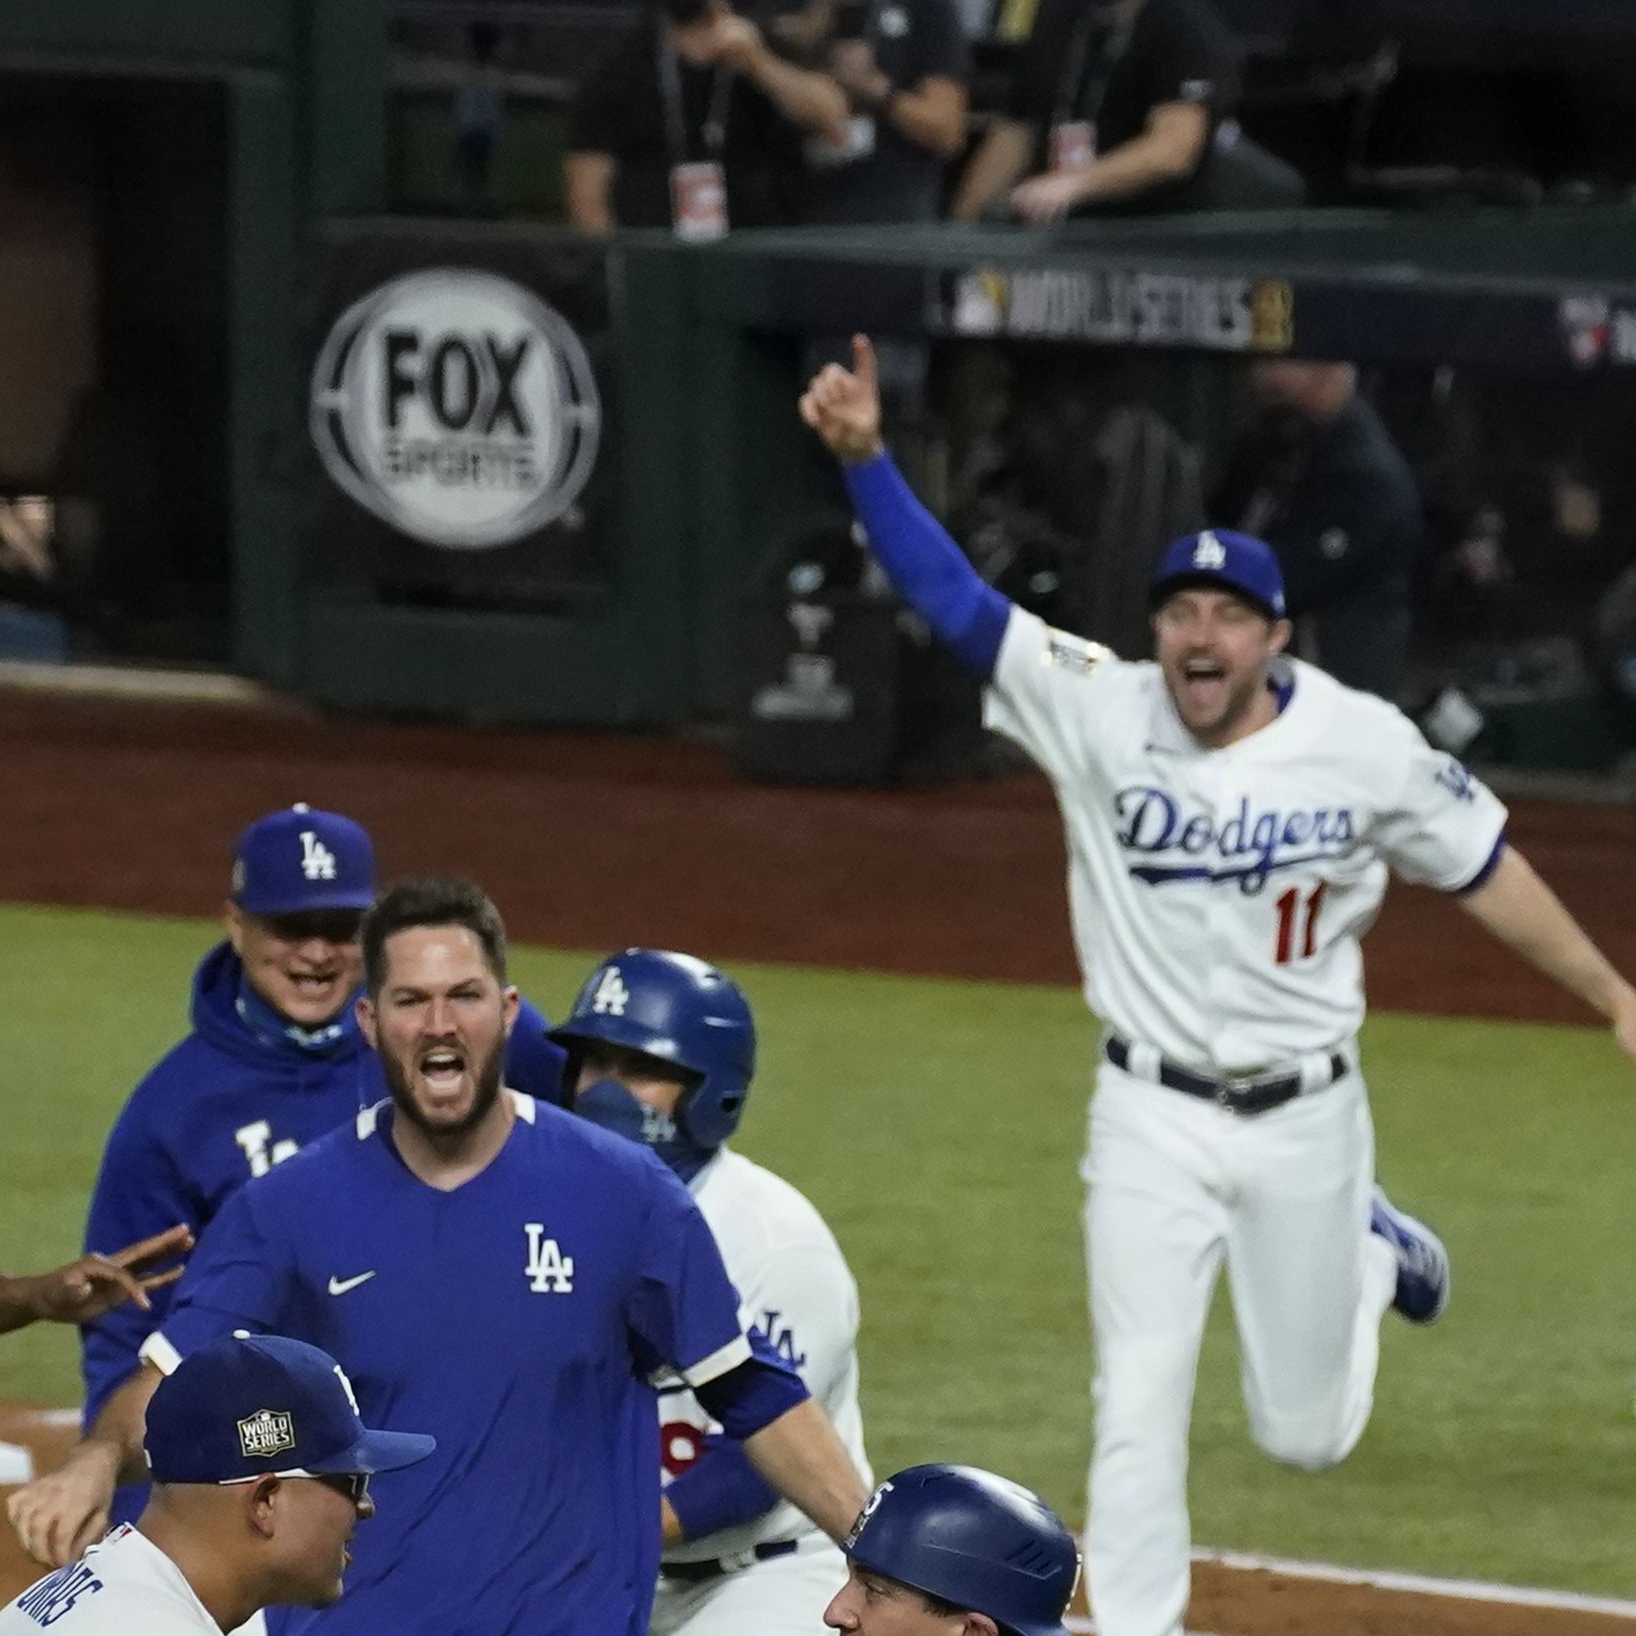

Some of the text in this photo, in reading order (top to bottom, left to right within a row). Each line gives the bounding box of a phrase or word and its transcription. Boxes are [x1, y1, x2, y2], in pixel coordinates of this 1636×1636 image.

[384, 328, 531, 438] FOX
[1193, 530, 1227, 570] LA
[299, 830, 337, 880] LA
[1114, 785, 1360, 895] Dodgers
[1275, 880, 1327, 966] 11
[593, 966, 630, 1017] LA
[234, 1119, 300, 1179] L
[523, 1223, 574, 1294] LA
[242, 1416, 288, 1438] WORLD
[244, 1430, 291, 1450] SERIES
